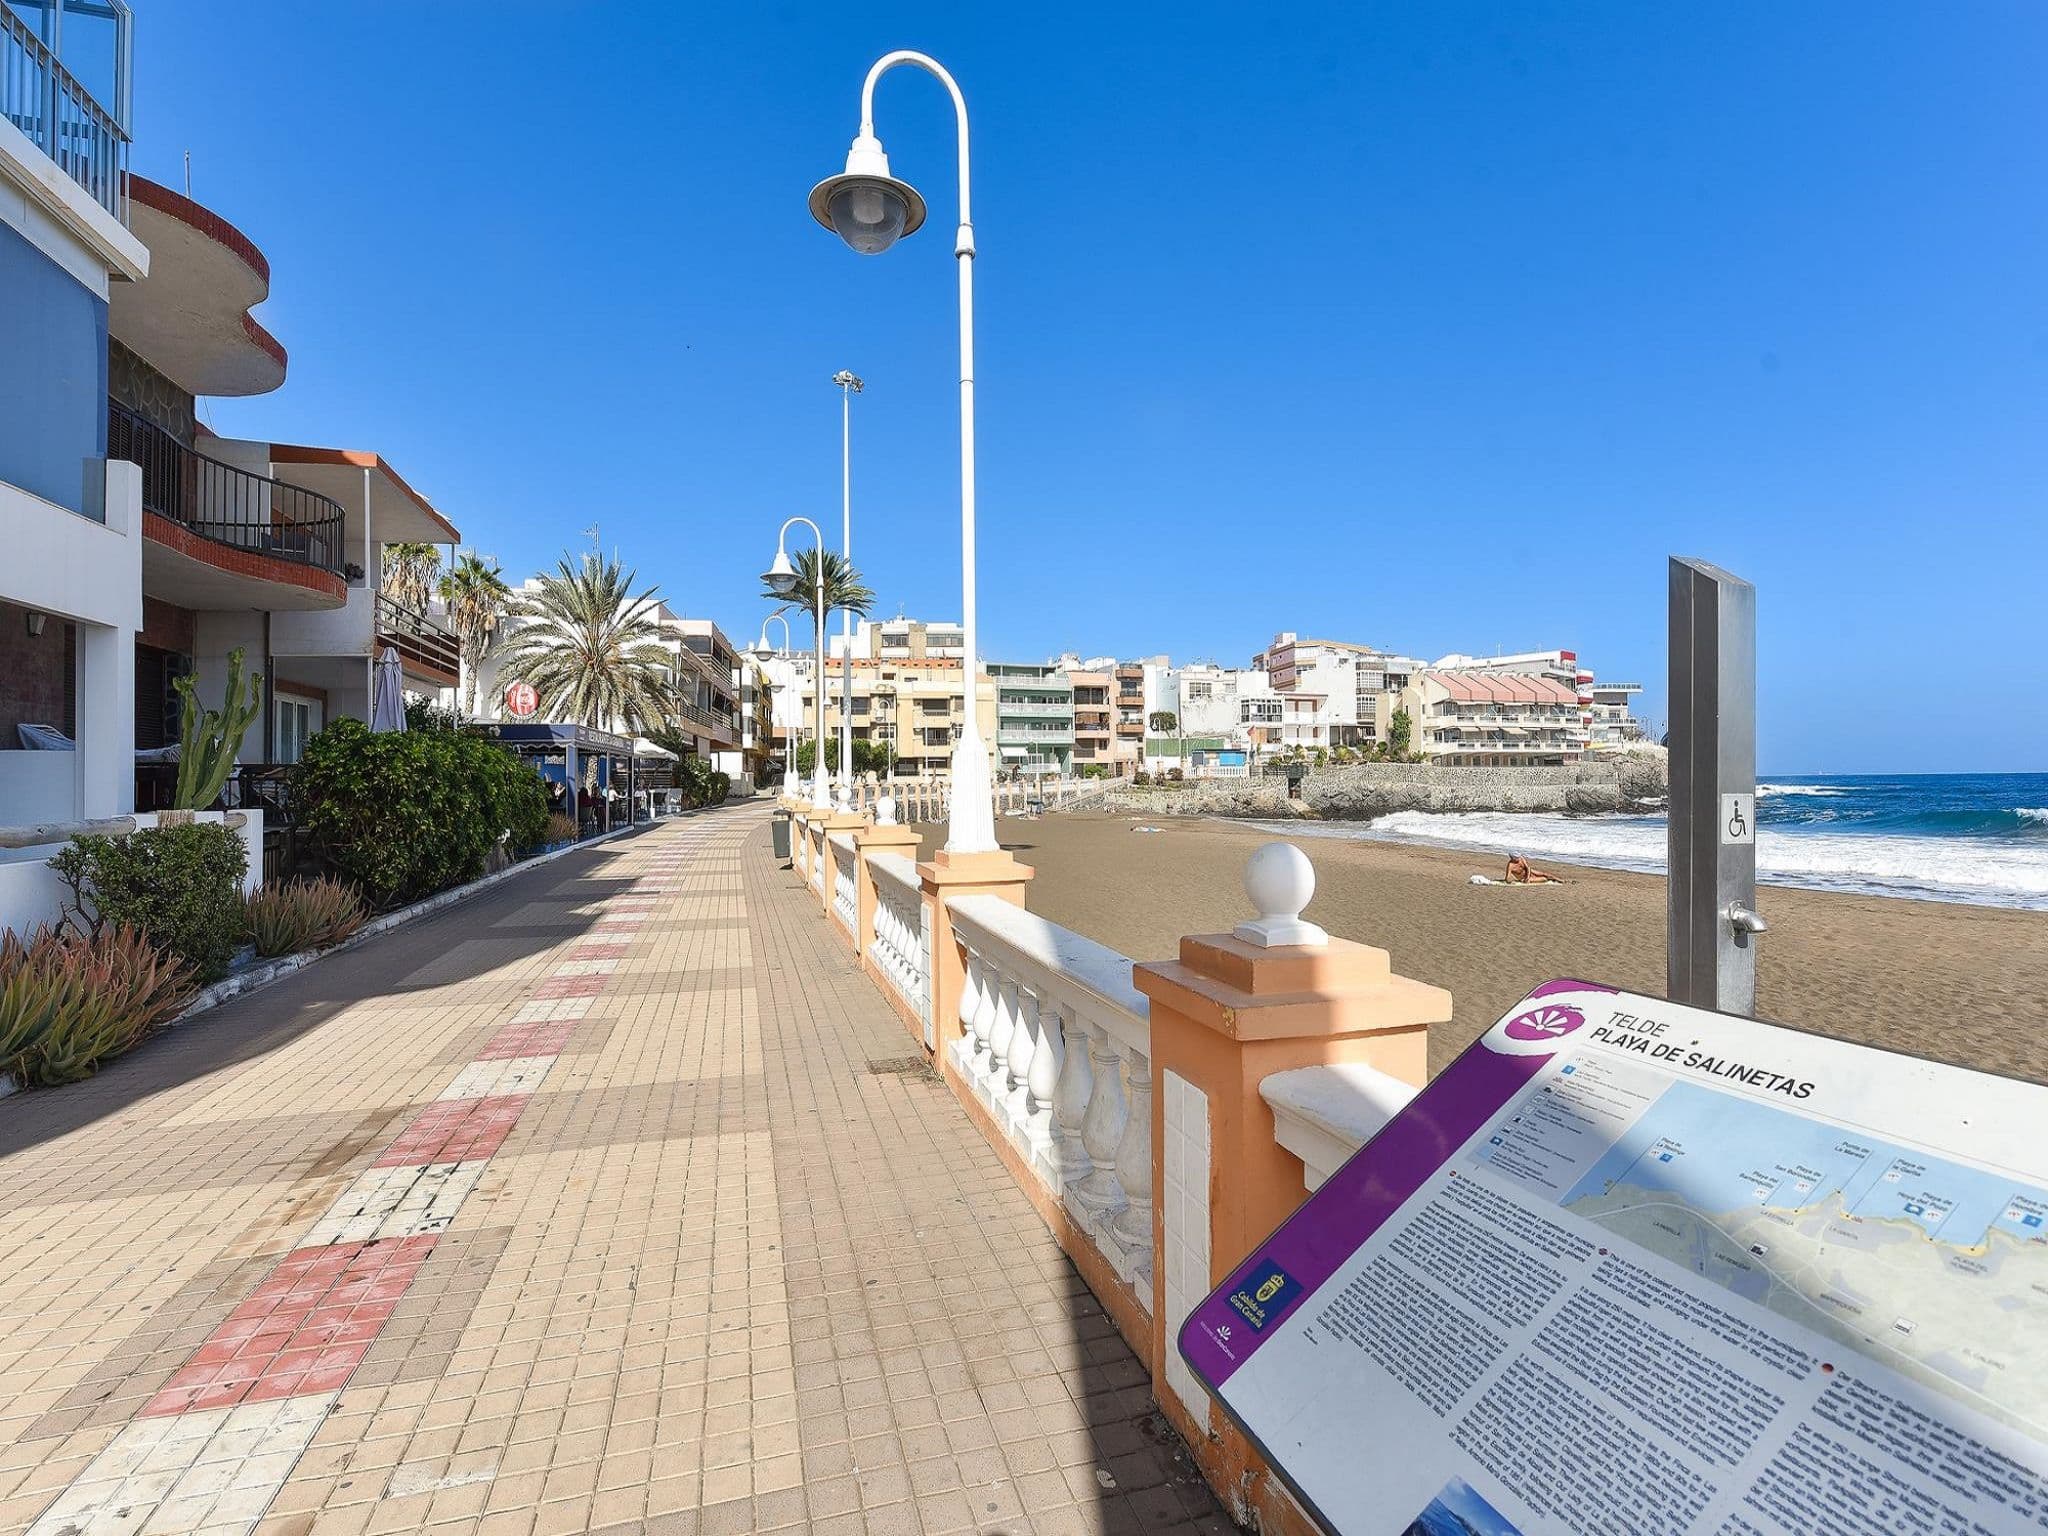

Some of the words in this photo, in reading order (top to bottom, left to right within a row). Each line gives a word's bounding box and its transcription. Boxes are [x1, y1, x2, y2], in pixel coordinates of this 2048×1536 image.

[1607, 1012, 1670, 1038] TELDE
[1590, 1027, 1651, 1054] PLAYA
[1650, 1043, 1686, 1063] DE
[1683, 1052, 1816, 1099] SALINETAS
[1230, 1295, 1245, 1311] Gran
